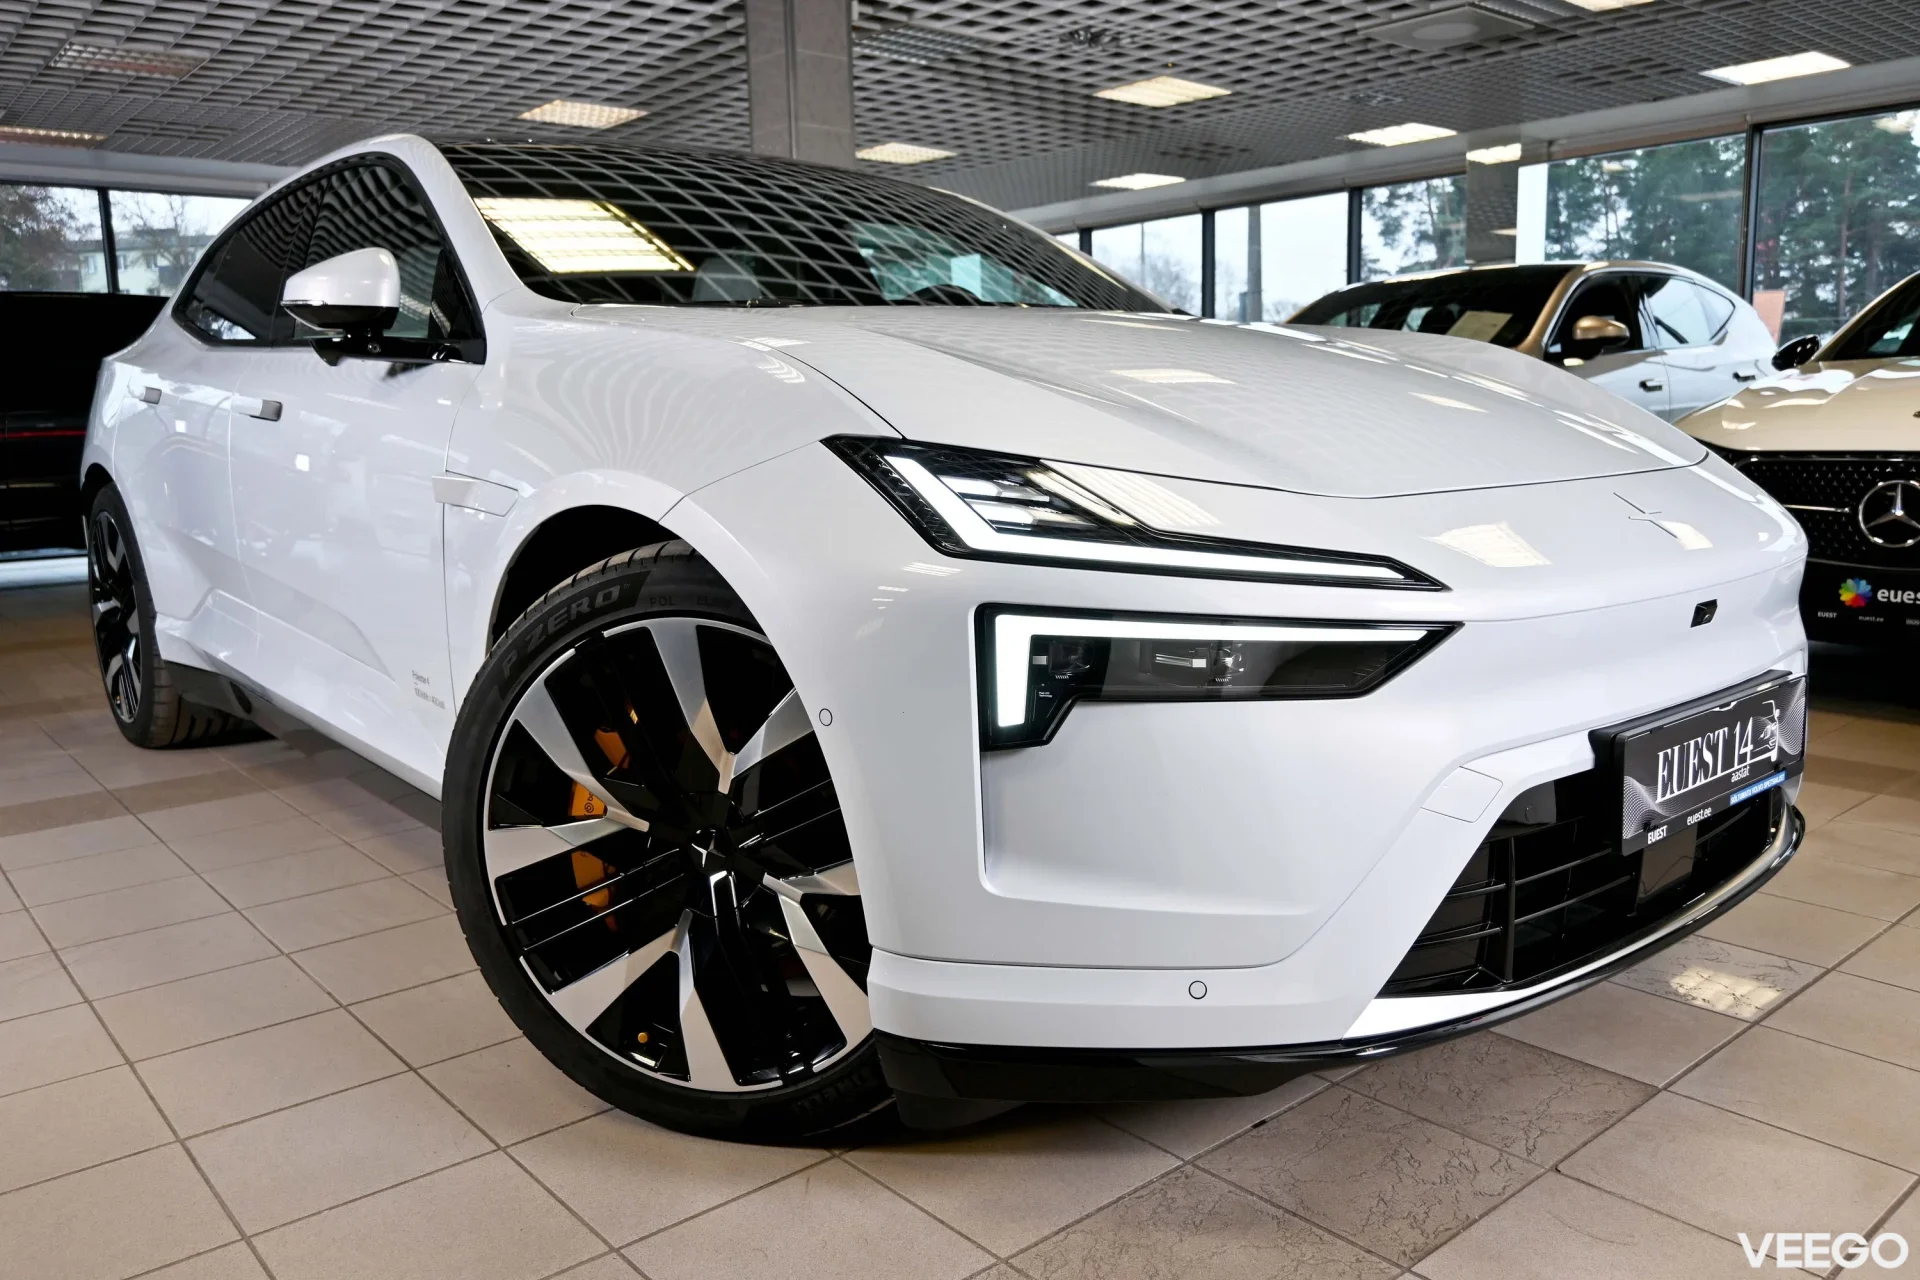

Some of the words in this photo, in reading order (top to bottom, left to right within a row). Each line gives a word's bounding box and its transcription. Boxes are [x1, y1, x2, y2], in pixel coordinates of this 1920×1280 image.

[1817, 611, 1838, 619] EUEST
[502, 650, 520, 680] P
[525, 585, 620, 653] ZERO
[1656, 727, 1728, 803] EUEST
[1734, 716, 1754, 769] 14
[1731, 765, 1750, 783] aastat
[1686, 807, 1712, 825] euest.ee
[1647, 825, 1668, 844] EUEST
